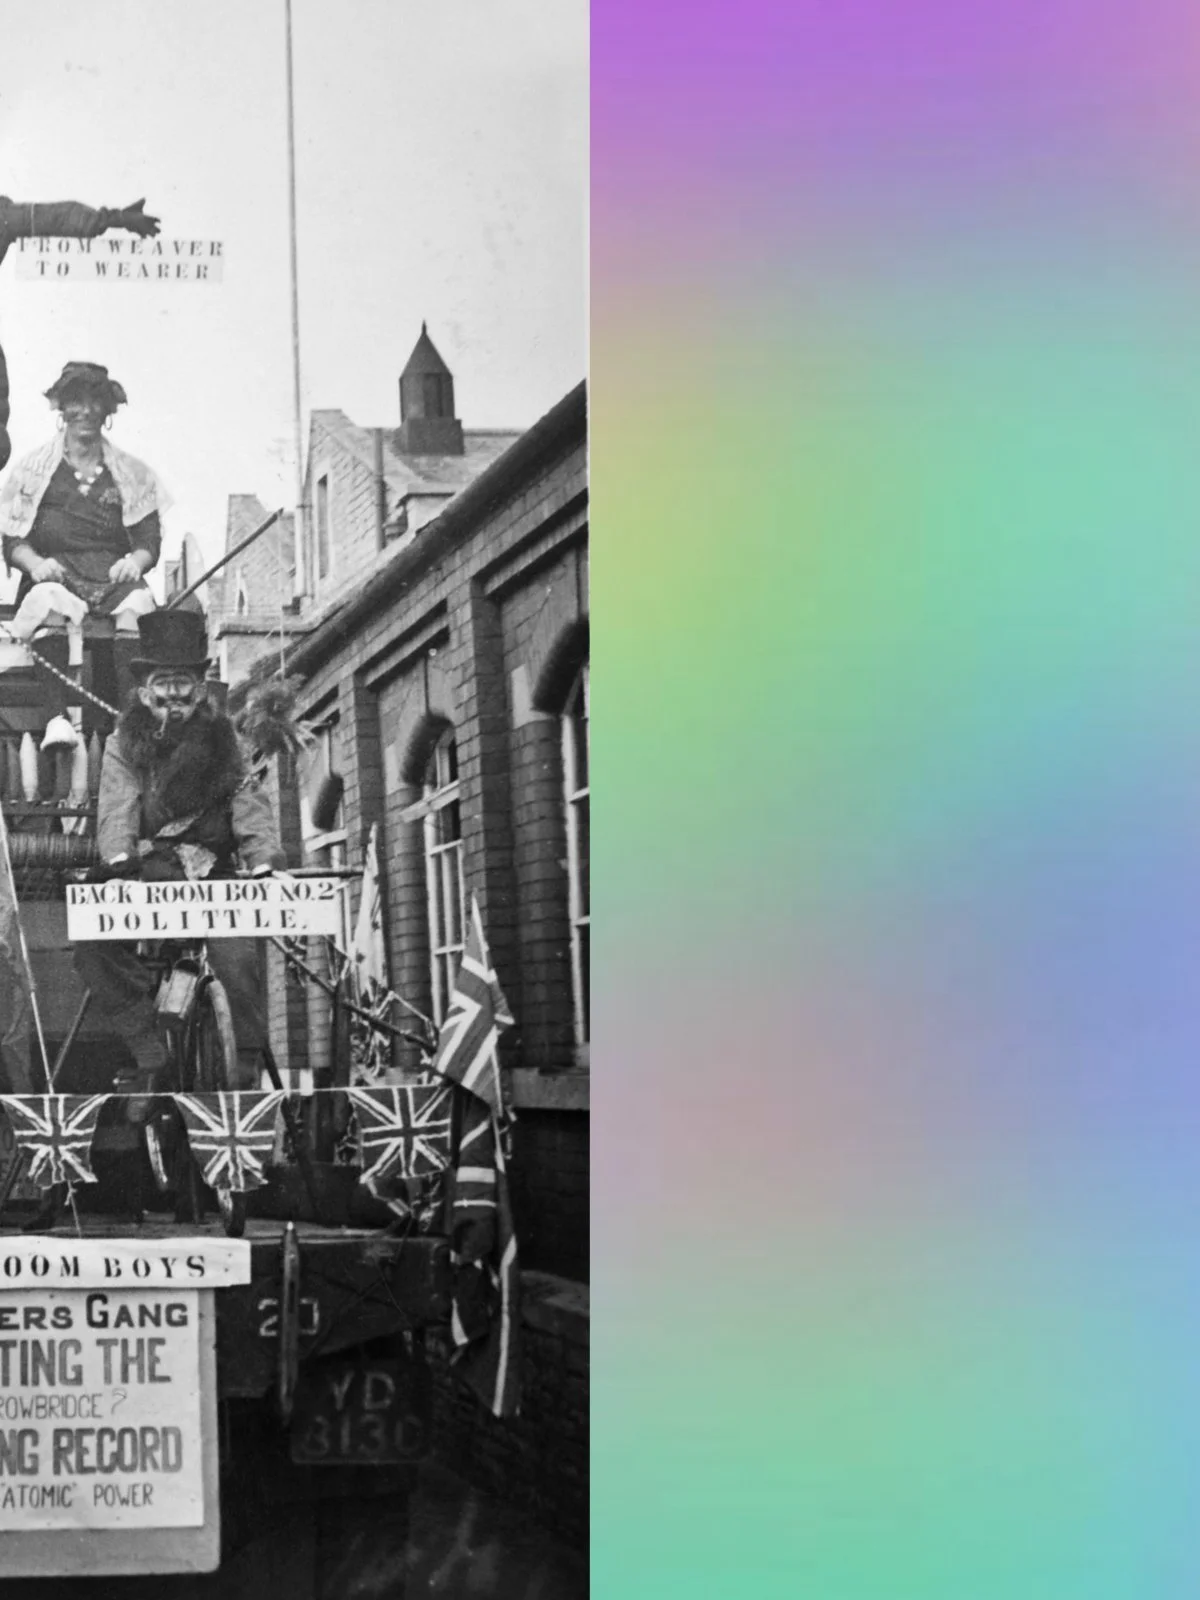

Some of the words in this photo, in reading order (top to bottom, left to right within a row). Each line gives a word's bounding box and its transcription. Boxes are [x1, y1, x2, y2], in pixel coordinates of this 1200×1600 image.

[19, 237, 92, 253] FROM
[108, 239, 224, 257] WEAVER
[36, 260, 70, 277] TO
[95, 262, 209, 280] WEARER
[70, 885, 134, 905] BACK
[146, 882, 213, 905] ROOM
[225, 882, 271, 901] BOY
[104, 1255, 207, 1279] BOYS
[96, 1337, 172, 1383] THE
[52, 1426, 183, 1477] RECORD
[93, 1483, 154, 1507] POWER
